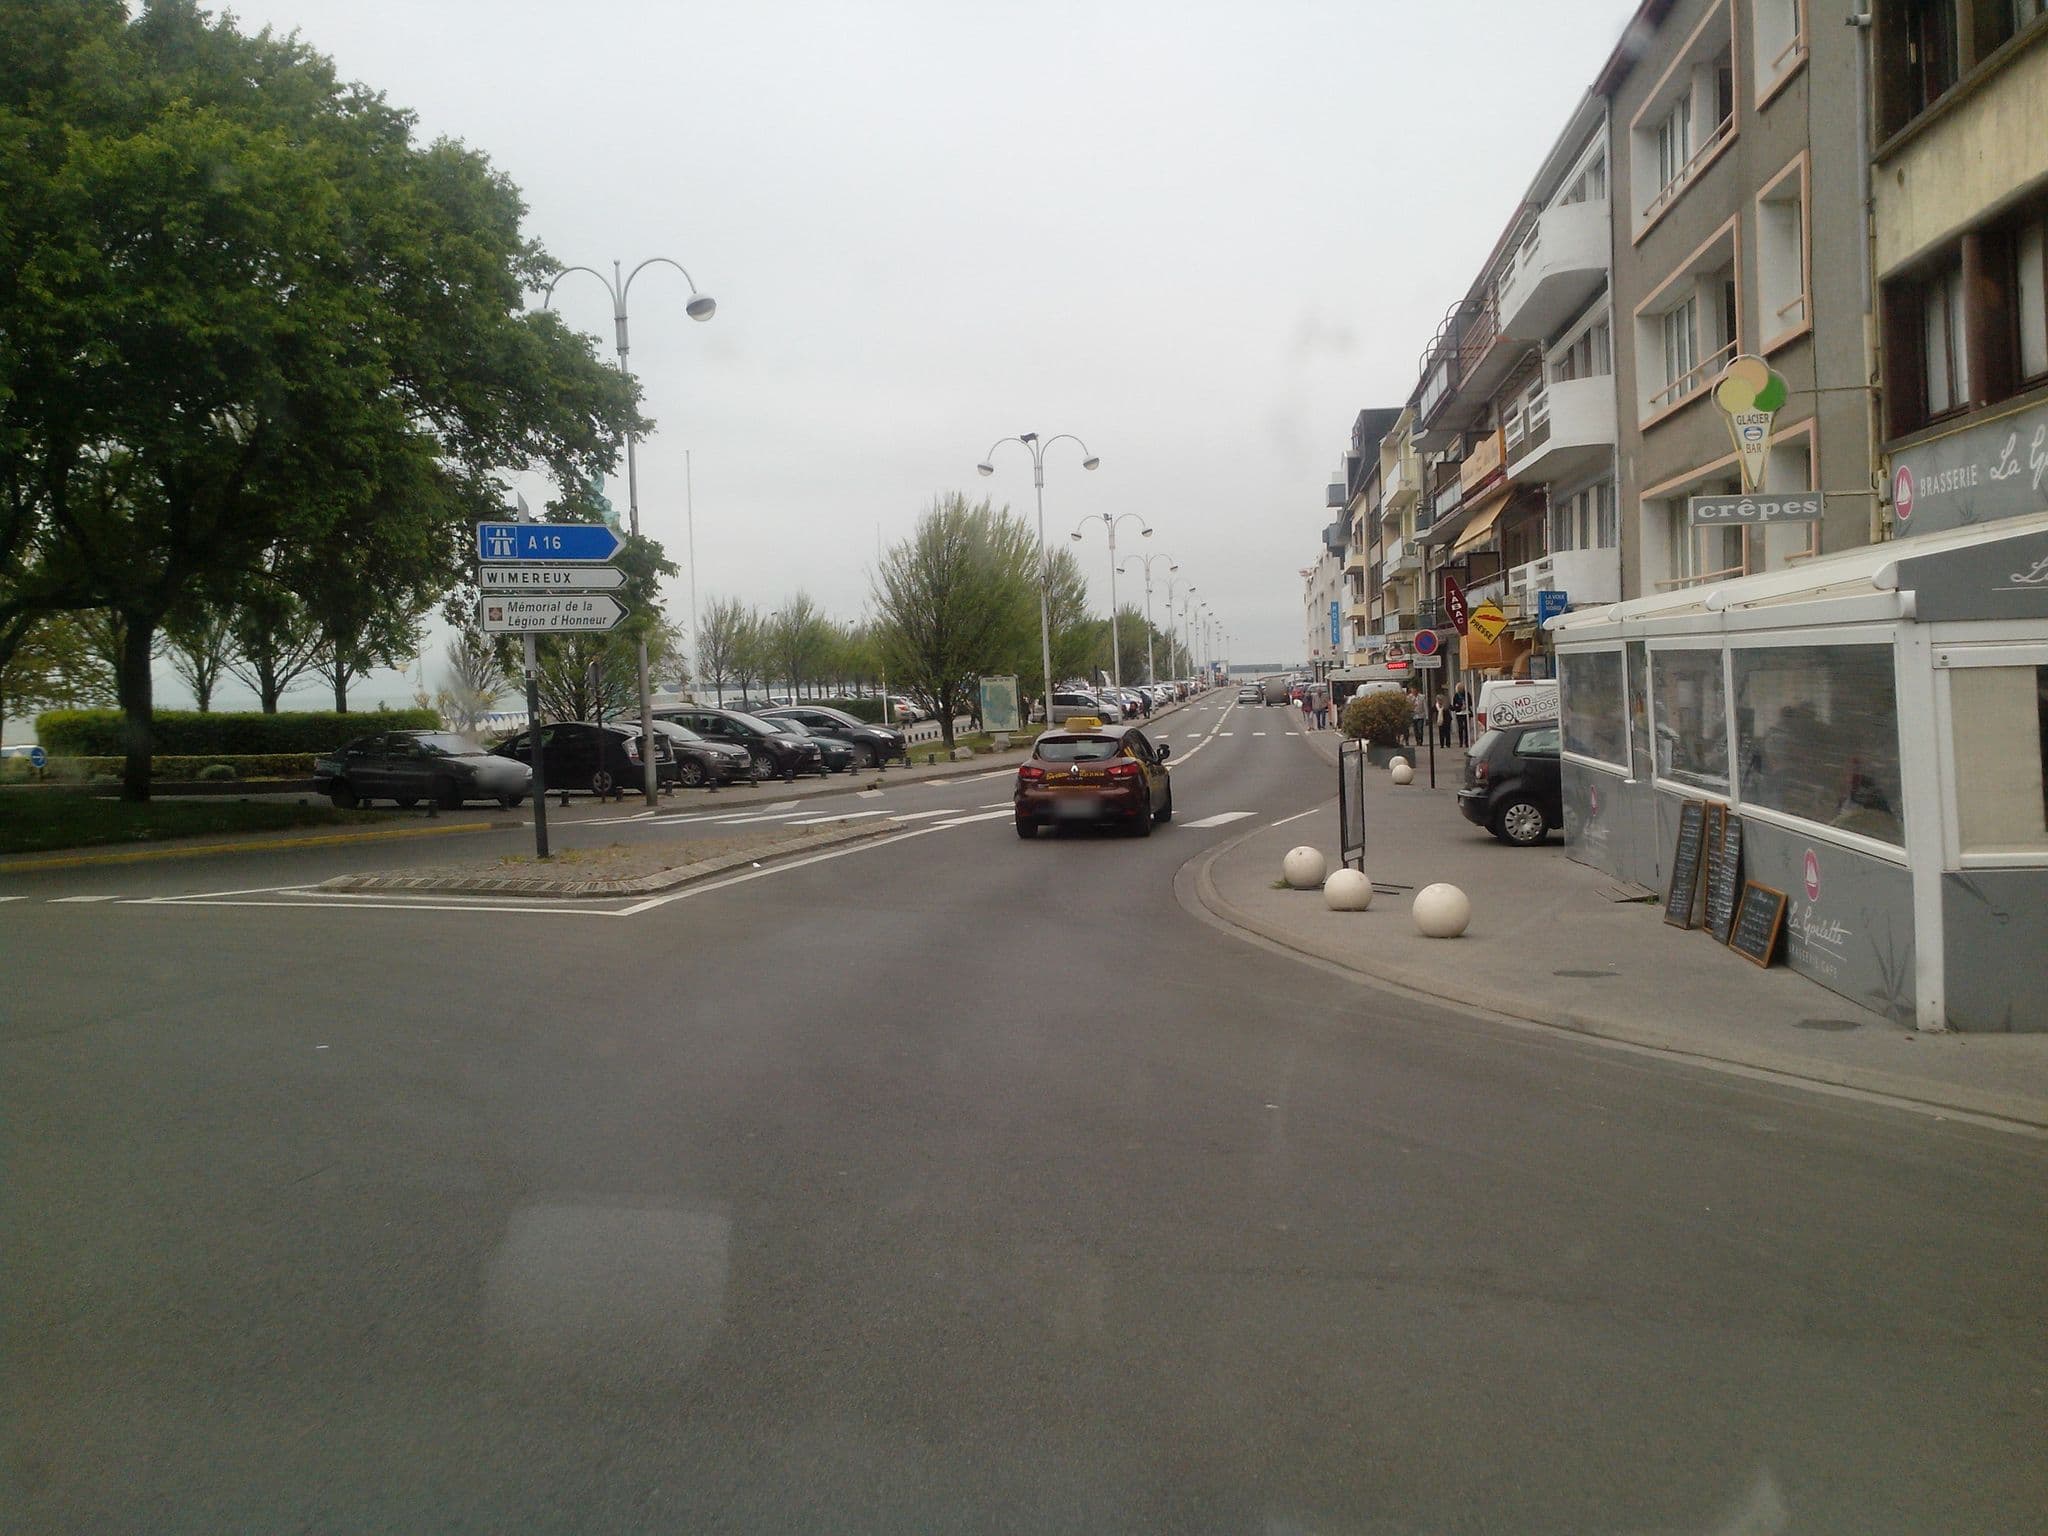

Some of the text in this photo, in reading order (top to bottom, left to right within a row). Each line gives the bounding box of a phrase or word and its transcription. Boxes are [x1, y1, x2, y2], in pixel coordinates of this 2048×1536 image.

[1736, 413, 1769, 425] GLACIER
[1745, 443, 1762, 454] BAR
[1920, 464, 1978, 498] BRASSERIE
[1990, 432, 2021, 480] La
[1698, 498, 1818, 521] crêpes
[528, 536, 561, 550] A 16
[487, 572, 571, 584] WIMEREUX
[507, 601, 593, 613] Mémorial de la
[1450, 590, 1463, 624] TABAC
[508, 614, 607, 628] Légion d'Honneur
[1470, 618, 1495, 641] PRESSE
[1514, 697, 1531, 709] MD
